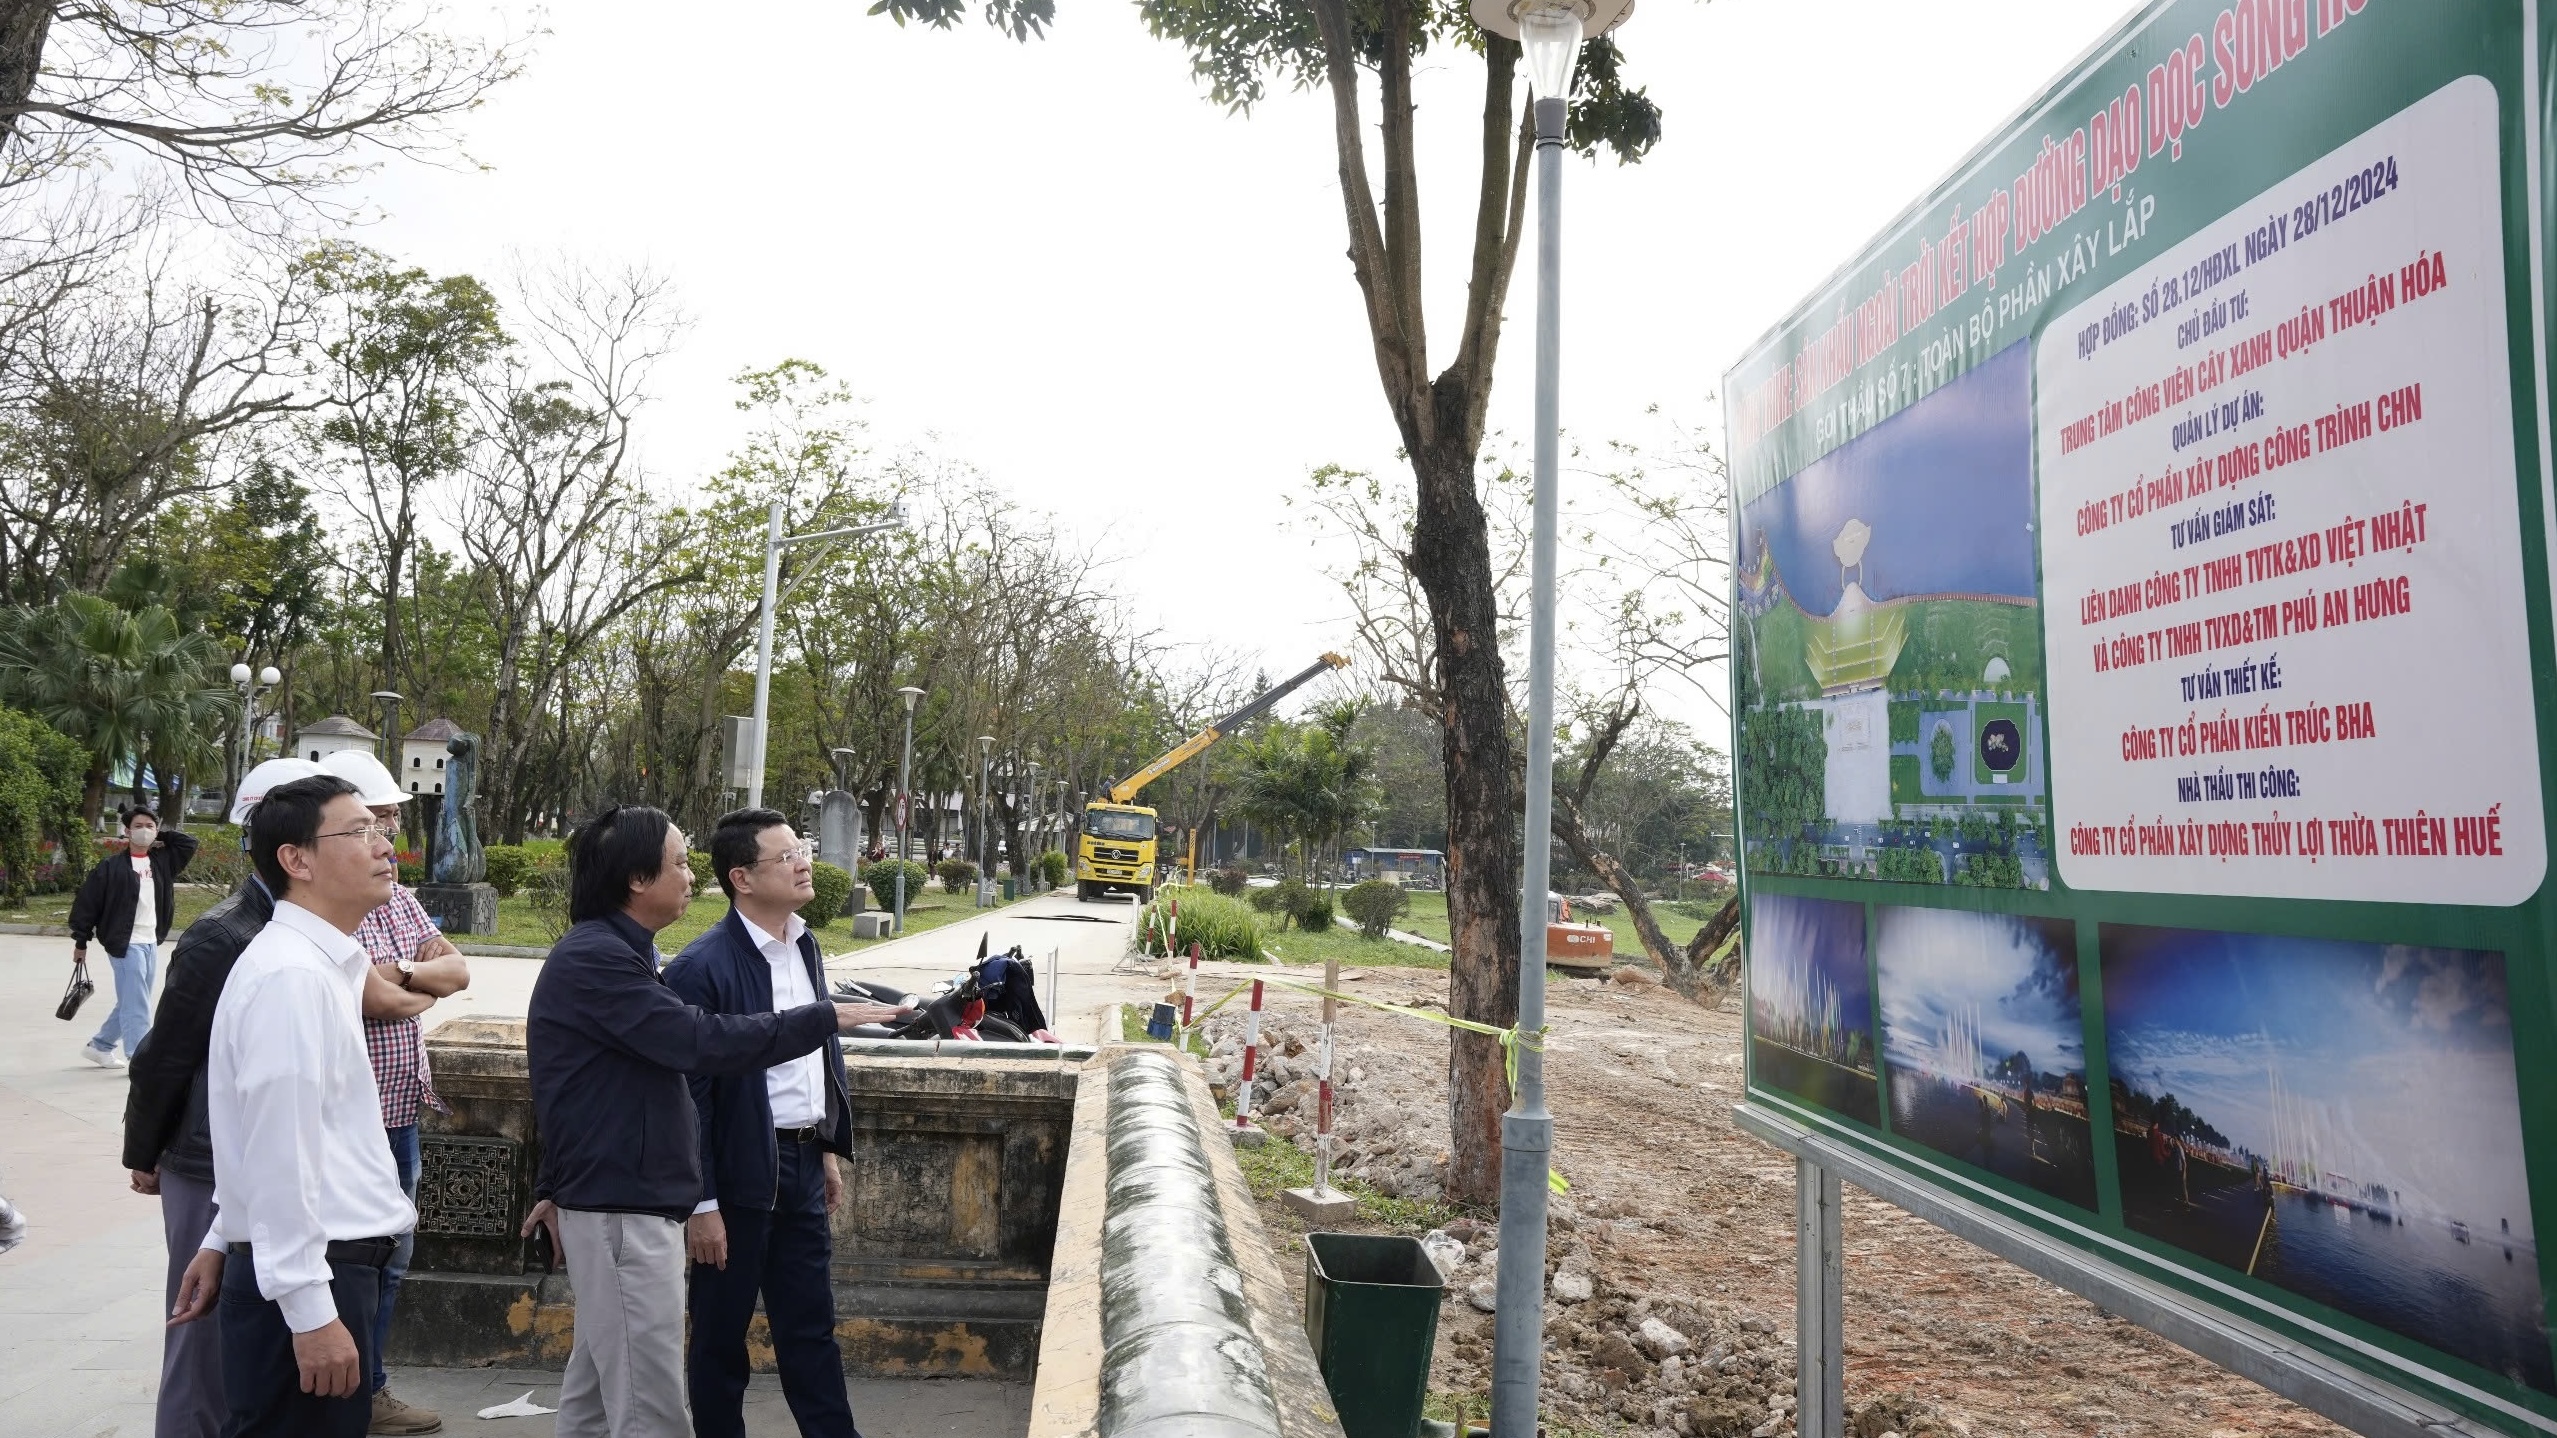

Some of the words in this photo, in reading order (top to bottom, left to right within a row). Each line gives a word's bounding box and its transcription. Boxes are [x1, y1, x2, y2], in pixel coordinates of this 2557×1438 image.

[1794, 336, 1819, 412] SÂN
[1856, 270, 1898, 369] NGOÀI
[1901, 237, 1935, 336] TRỜI
[1938, 203, 1969, 311] KẾT
[1973, 188, 2009, 291] HỢP
[2013, 128, 2087, 256] ĐƯỜNG
[2091, 83, 2141, 204] DẠO
[2147, 33, 2205, 163] DỌC
[2078, 323, 2099, 361] HỢP
[2102, 299, 2138, 345] ĐỒNG:
[2142, 276, 2160, 324] SỐ
[2162, 242, 2241, 313] 28.12/HĐXL
[2245, 213, 2288, 268] NGÀY
[2293, 155, 2398, 242] 28/12/2024
[1878, 356, 1897, 407] SỐ
[1901, 362, 1909, 392] 7
[1921, 324, 1963, 377] TOÀN
[1970, 297, 1994, 348] BỘ
[1999, 261, 2051, 328] PHẦN
[2057, 229, 2100, 291] XÂY
[2109, 188, 2155, 256] LẮP
[2178, 308, 2200, 349] CHỦ
[2203, 298, 2226, 337] ĐẦU
[2229, 289, 2249, 323] TƯ:
[2060, 414, 2095, 455] TRUNG
[2098, 400, 2122, 438] TÂM
[2126, 383, 2160, 425] CÔNG
[2163, 366, 2194, 408] VIÊN
[2198, 350, 2225, 393] CÂY
[2230, 330, 2272, 379] XANH
[2277, 305, 2324, 360] QUẬN
[2329, 273, 2395, 334] THUẬN
[2401, 250, 2447, 304] HÓA
[2077, 499, 2108, 537] CÔNG
[2110, 493, 2124, 524] TY
[2128, 474, 2144, 519] CỔ
[2147, 464, 2183, 512] PHẦN
[2186, 456, 2213, 498] XÂY
[2217, 442, 2260, 490] DỰNG
[2264, 424, 2310, 471] CÔNG
[2314, 400, 2372, 453] TRÌNH
[2377, 383, 2422, 432] CHN
[2172, 413, 2203, 452] QUẢN
[2205, 403, 2218, 439] LÝ
[2222, 396, 2239, 432] DỰ
[2242, 391, 2264, 423] ÁN:
[2171, 518, 2185, 550] TƯ
[2187, 509, 2210, 545] VẤN
[2213, 501, 2245, 537] GIÁM
[2248, 490, 2275, 526] SÁT:
[2081, 589, 2106, 625] LIÊN
[2109, 582, 2142, 618] DANH
[2145, 570, 2182, 609] CÔNG
[2183, 565, 2199, 599] TY
[2203, 554, 2242, 594] TNHH
[2246, 533, 2321, 583] TVTK&XD
[2325, 517, 2365, 568] VIỆT
[2371, 500, 2427, 554] NHẬT
[2094, 637, 2109, 673] VÀ
[2112, 632, 2145, 669] CÔNG
[2147, 630, 2162, 662] TY
[2165, 621, 2202, 658] TNHH
[2204, 604, 2278, 650] TVXD&TM
[2282, 588, 2318, 636] PHÚ
[2323, 589, 2349, 628] AN
[2353, 576, 2411, 622] HƯNG
[2181, 673, 2195, 702] TƯ
[2197, 663, 2221, 700] VẤN
[2224, 657, 2257, 696] THIẾT
[2260, 652, 2282, 690] KẾ:
[2122, 725, 2157, 762] CÔNG
[2159, 727, 2174, 758] TY
[2178, 711, 2196, 756] CỔ
[2200, 708, 2241, 754] PHẦN
[2244, 704, 2282, 750] KIẾN
[2285, 701, 2331, 746] TRÚC
[2335, 702, 2376, 740] BHA
[2178, 771, 2202, 802] NHÀ
[2203, 765, 2234, 801] THẦU
[2236, 772, 2257, 799] THI
[2259, 765, 2300, 799] CÔNG:
[2071, 822, 2101, 856] CÔNG
[2102, 827, 2116, 855] TY
[2119, 814, 2136, 856] CỔ
[2139, 815, 2175, 855] PHẦN
[2177, 818, 2203, 855] XÂY
[2207, 820, 2249, 862] DỰNG
[2251, 810, 2291, 856] THỦY
[2296, 817, 2324, 863] LỢI
[2328, 811, 2379, 856] THỪA
[2382, 810, 2447, 856] THIÊN
[2454, 803, 2503, 856] HUẾ
